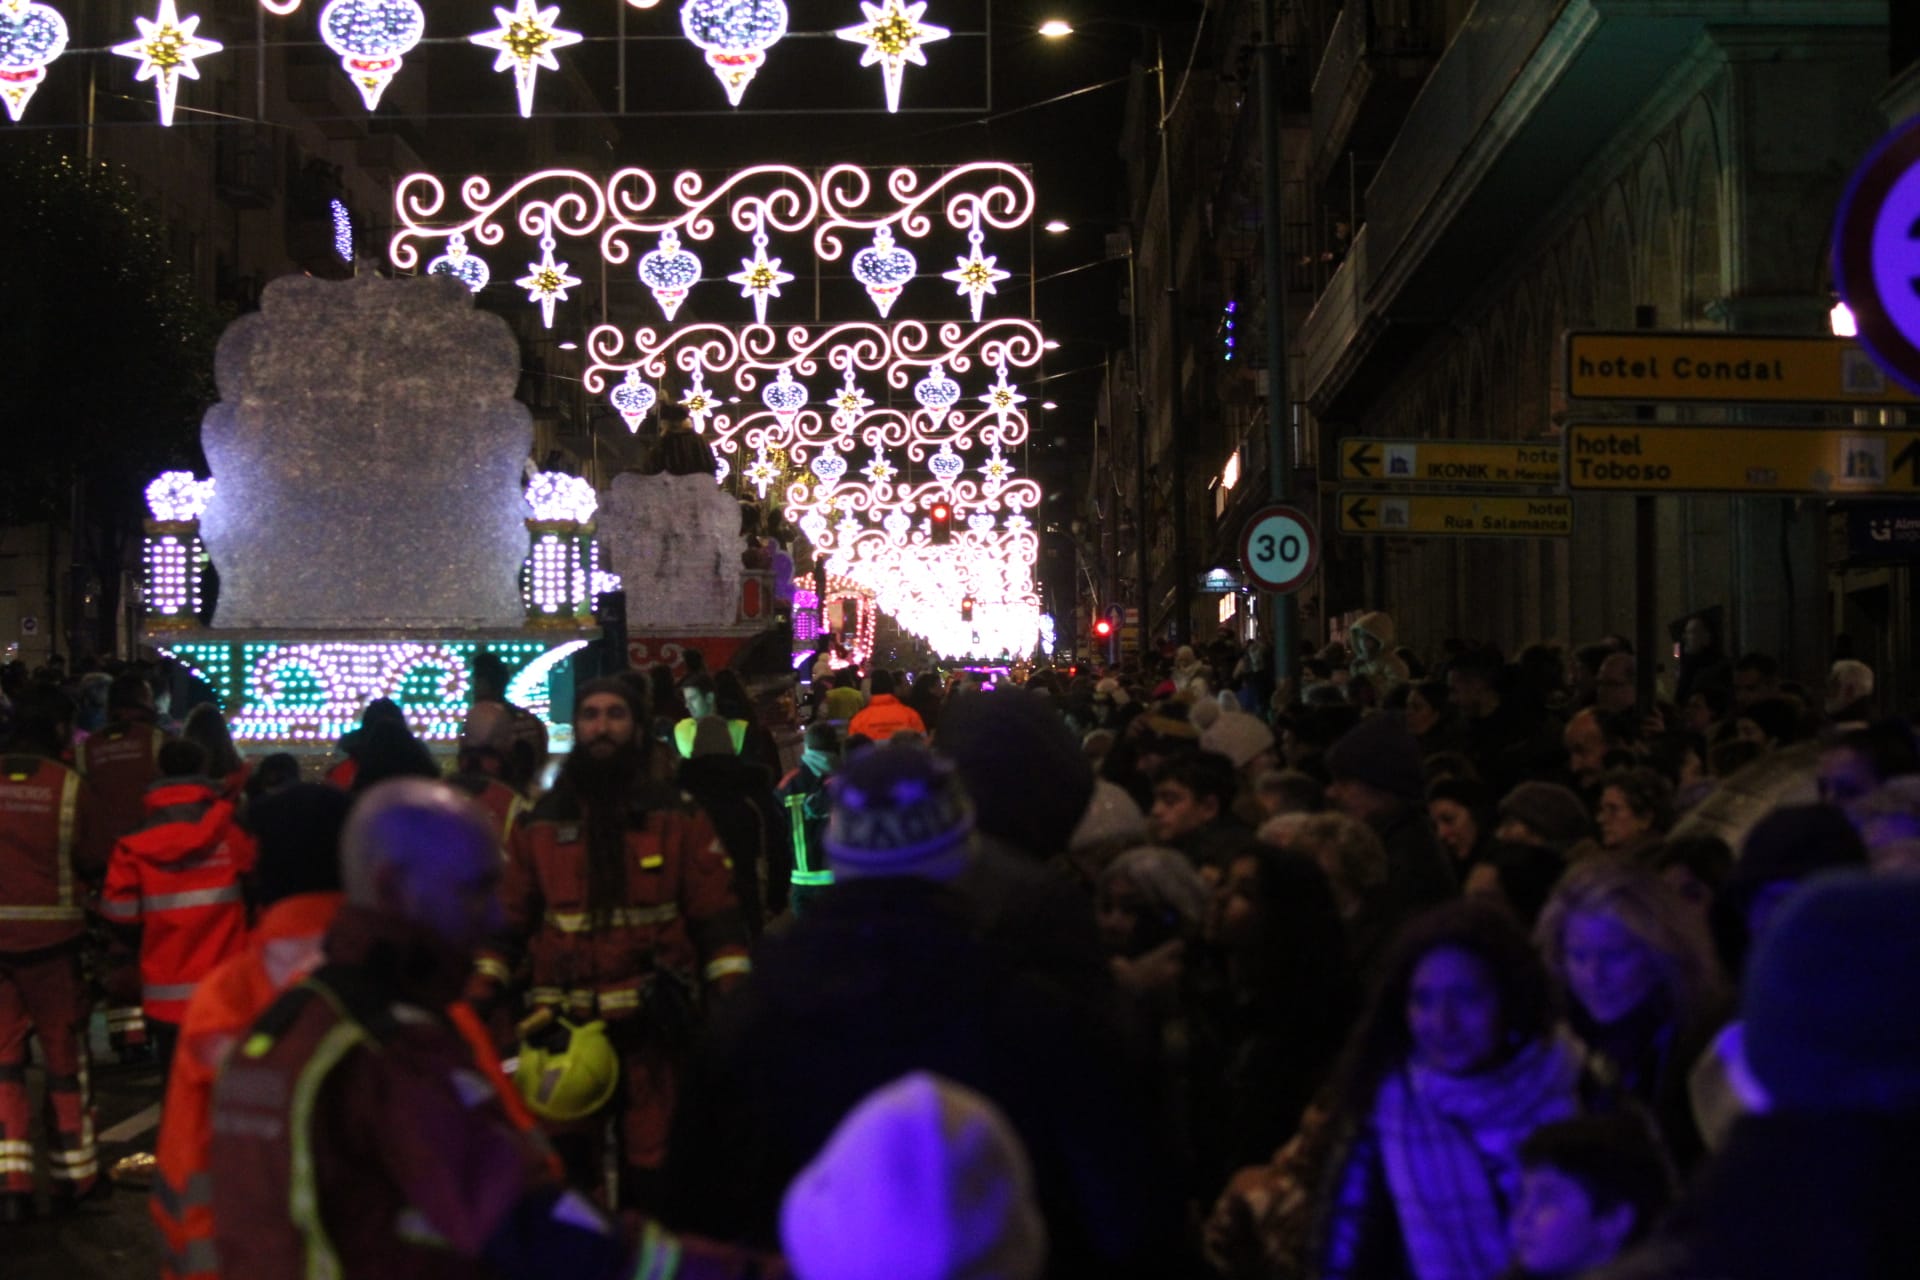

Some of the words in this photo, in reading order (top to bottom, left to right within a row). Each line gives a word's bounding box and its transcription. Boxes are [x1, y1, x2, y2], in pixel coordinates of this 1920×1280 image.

[1578, 354, 1659, 378] hotel
[1672, 357, 1784, 380] Condal
[1576, 432, 1642, 455] hotel
[1518, 449, 1558, 463] hote
[1427, 463, 1488, 479] IKONIK
[1576, 458, 1671, 480] Toboso
[1528, 502, 1567, 515] hotel
[1482, 515, 1568, 530] Salamanca
[1257, 534, 1300, 561] 30
